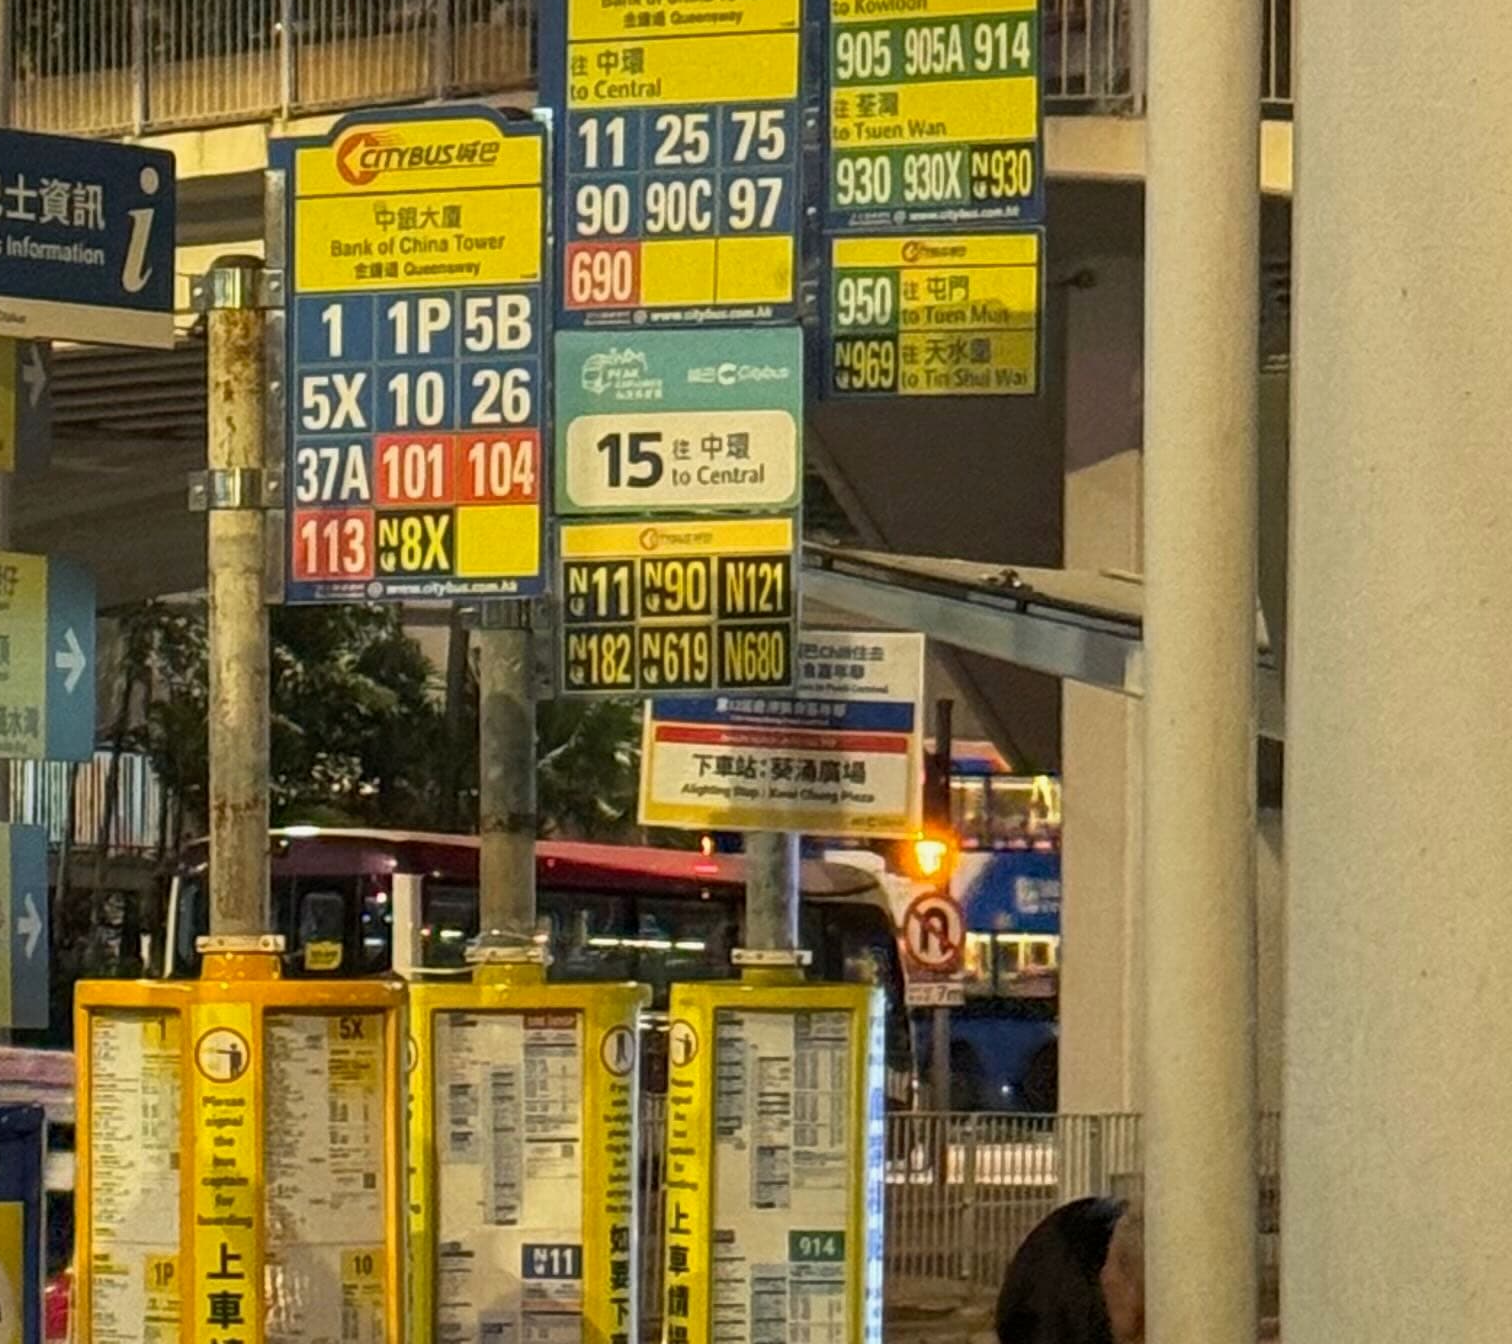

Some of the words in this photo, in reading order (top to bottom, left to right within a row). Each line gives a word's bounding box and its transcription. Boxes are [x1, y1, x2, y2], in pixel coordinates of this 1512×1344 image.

[670, 10, 743, 26] Queensway
[571, 55, 588, 77] 往
[597, 48, 645, 75] 中環
[838, 30, 891, 81] 905
[905, 24, 965, 76] 905A
[974, 21, 1030, 72] 914
[570, 81, 588, 101] to
[594, 79, 661, 99] Central
[579, 117, 624, 168] 11
[655, 114, 710, 164] 25
[732, 110, 785, 161] 75
[833, 125, 850, 141] to
[854, 122, 903, 140] Tsuen
[907, 119, 947, 137] Wan
[359, 142, 455, 170] CITYBUS
[837, 156, 891, 204] 930
[903, 151, 962, 201] 930X
[375, 205, 462, 230] 中銀大廈
[577, 184, 629, 235] 90
[646, 179, 711, 232] 90C
[729, 178, 783, 229] 97
[121, 167, 160, 293] i
[6, 234, 105, 266] Information
[331, 239, 371, 257] Bank
[377, 238, 395, 255] of
[399, 236, 448, 254] China
[453, 232, 505, 252] Tower
[403, 260, 481, 278] Queensway
[572, 250, 632, 302] 690
[837, 277, 891, 326] 950
[926, 275, 969, 301] 屯門
[902, 308, 920, 325] to
[923, 306, 968, 324] Tuen
[971, 304, 1010, 323] Mun
[322, 303, 342, 357] 1
[388, 298, 451, 355] 1P
[465, 294, 532, 352] 5B
[924, 338, 991, 365] 天水圍
[901, 372, 918, 389] to
[924, 370, 950, 387] Tin
[956, 371, 988, 388] Shui
[995, 371, 1027, 387] Wai
[303, 374, 366, 431] 5X
[388, 372, 445, 427] 10
[472, 369, 531, 424] 26
[297, 445, 370, 504] 37A
[384, 443, 444, 500] 101
[469, 440, 535, 497] 104
[597, 432, 663, 488] 15
[701, 432, 749, 460] 中環
[671, 467, 690, 487] to
[697, 463, 764, 486] Central
[302, 519, 365, 573] 113
[386, 580, 518, 597] www.citybus.com.hk
[725, 563, 783, 613] N121
[725, 631, 783, 681] N680
[339, 1017, 365, 1040] 5X
[800, 1239, 836, 1257] 914
[154, 1263, 175, 1286] 1P
[354, 1255, 374, 1275] 10
